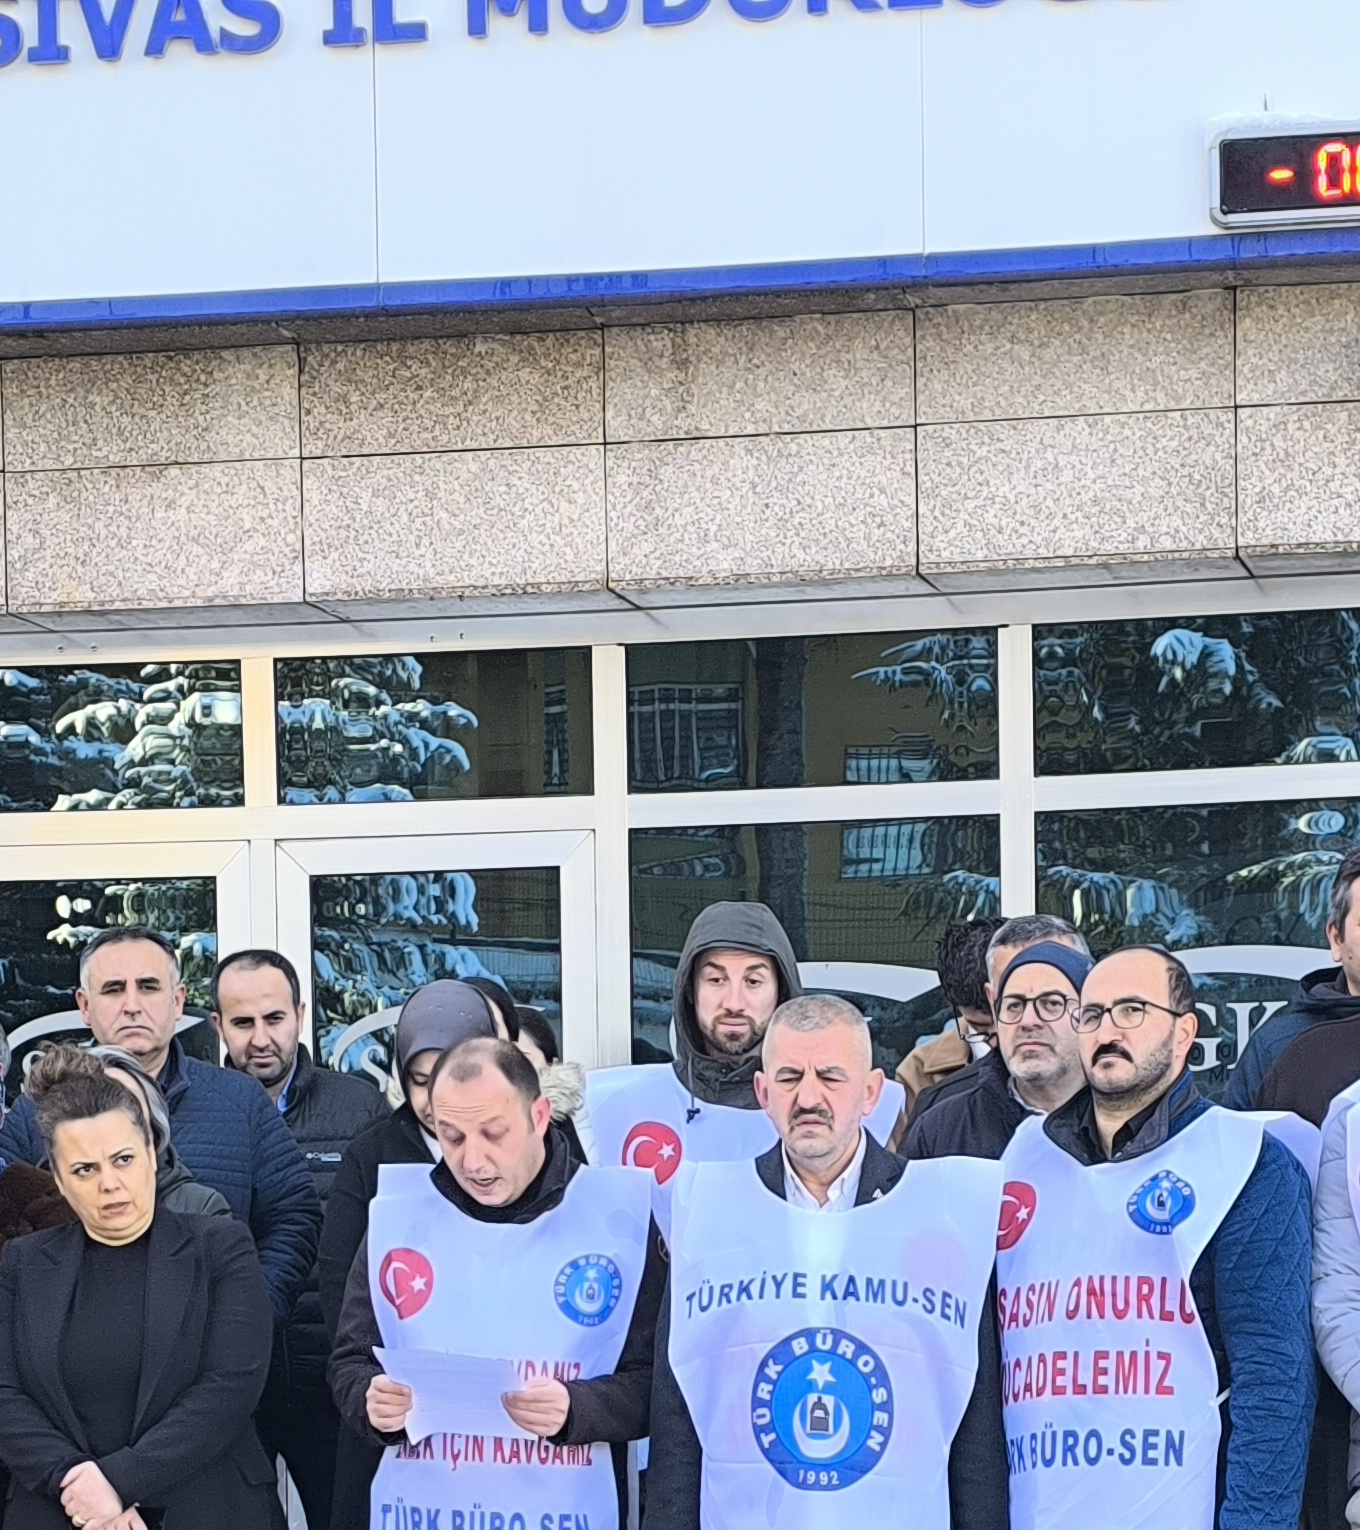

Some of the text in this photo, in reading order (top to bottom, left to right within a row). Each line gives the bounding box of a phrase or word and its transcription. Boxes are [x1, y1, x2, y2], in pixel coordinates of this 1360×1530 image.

[685, 1270, 968, 1330] TÜRKİYE KAMU-SEN
[1065, 1275, 1196, 1325] ONURLU
[752, 1329, 890, 1452] TÜRK BÜRO-SEN
[1030, 1422, 1185, 1469] BÜRO-SEN
[798, 1469, 840, 1485] 1992
